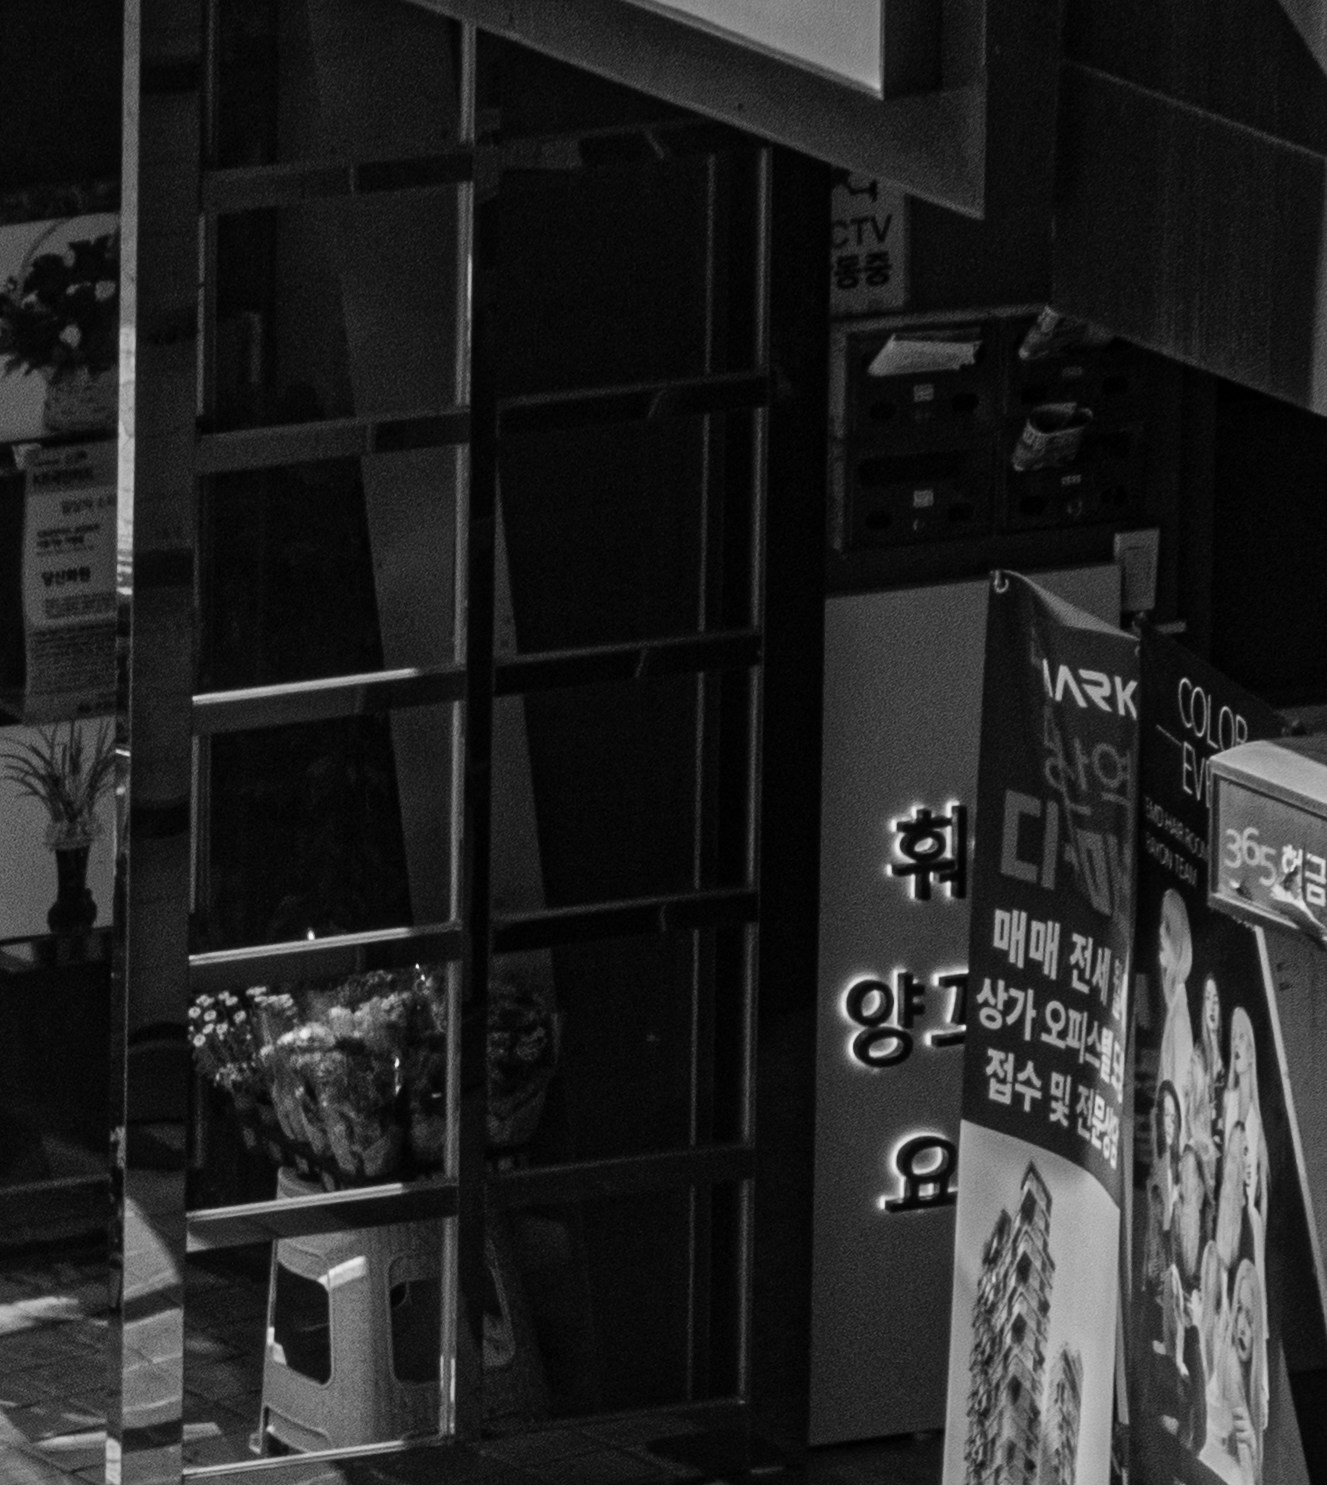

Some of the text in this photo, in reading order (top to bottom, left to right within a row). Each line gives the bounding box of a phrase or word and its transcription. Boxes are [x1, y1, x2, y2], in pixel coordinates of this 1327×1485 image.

[830, 213, 893, 249] CTV
[1178, 676, 1248, 751] COLOR
[1182, 741, 1210, 809] EV
[1224, 827, 1277, 887] 365
[992, 907, 1061, 981] 매매
[1069, 932, 1112, 1007] 전세
[976, 977, 1037, 1042] 상가
[984, 1047, 1043, 1114] 접수
[1049, 1071, 1072, 1129] 및
